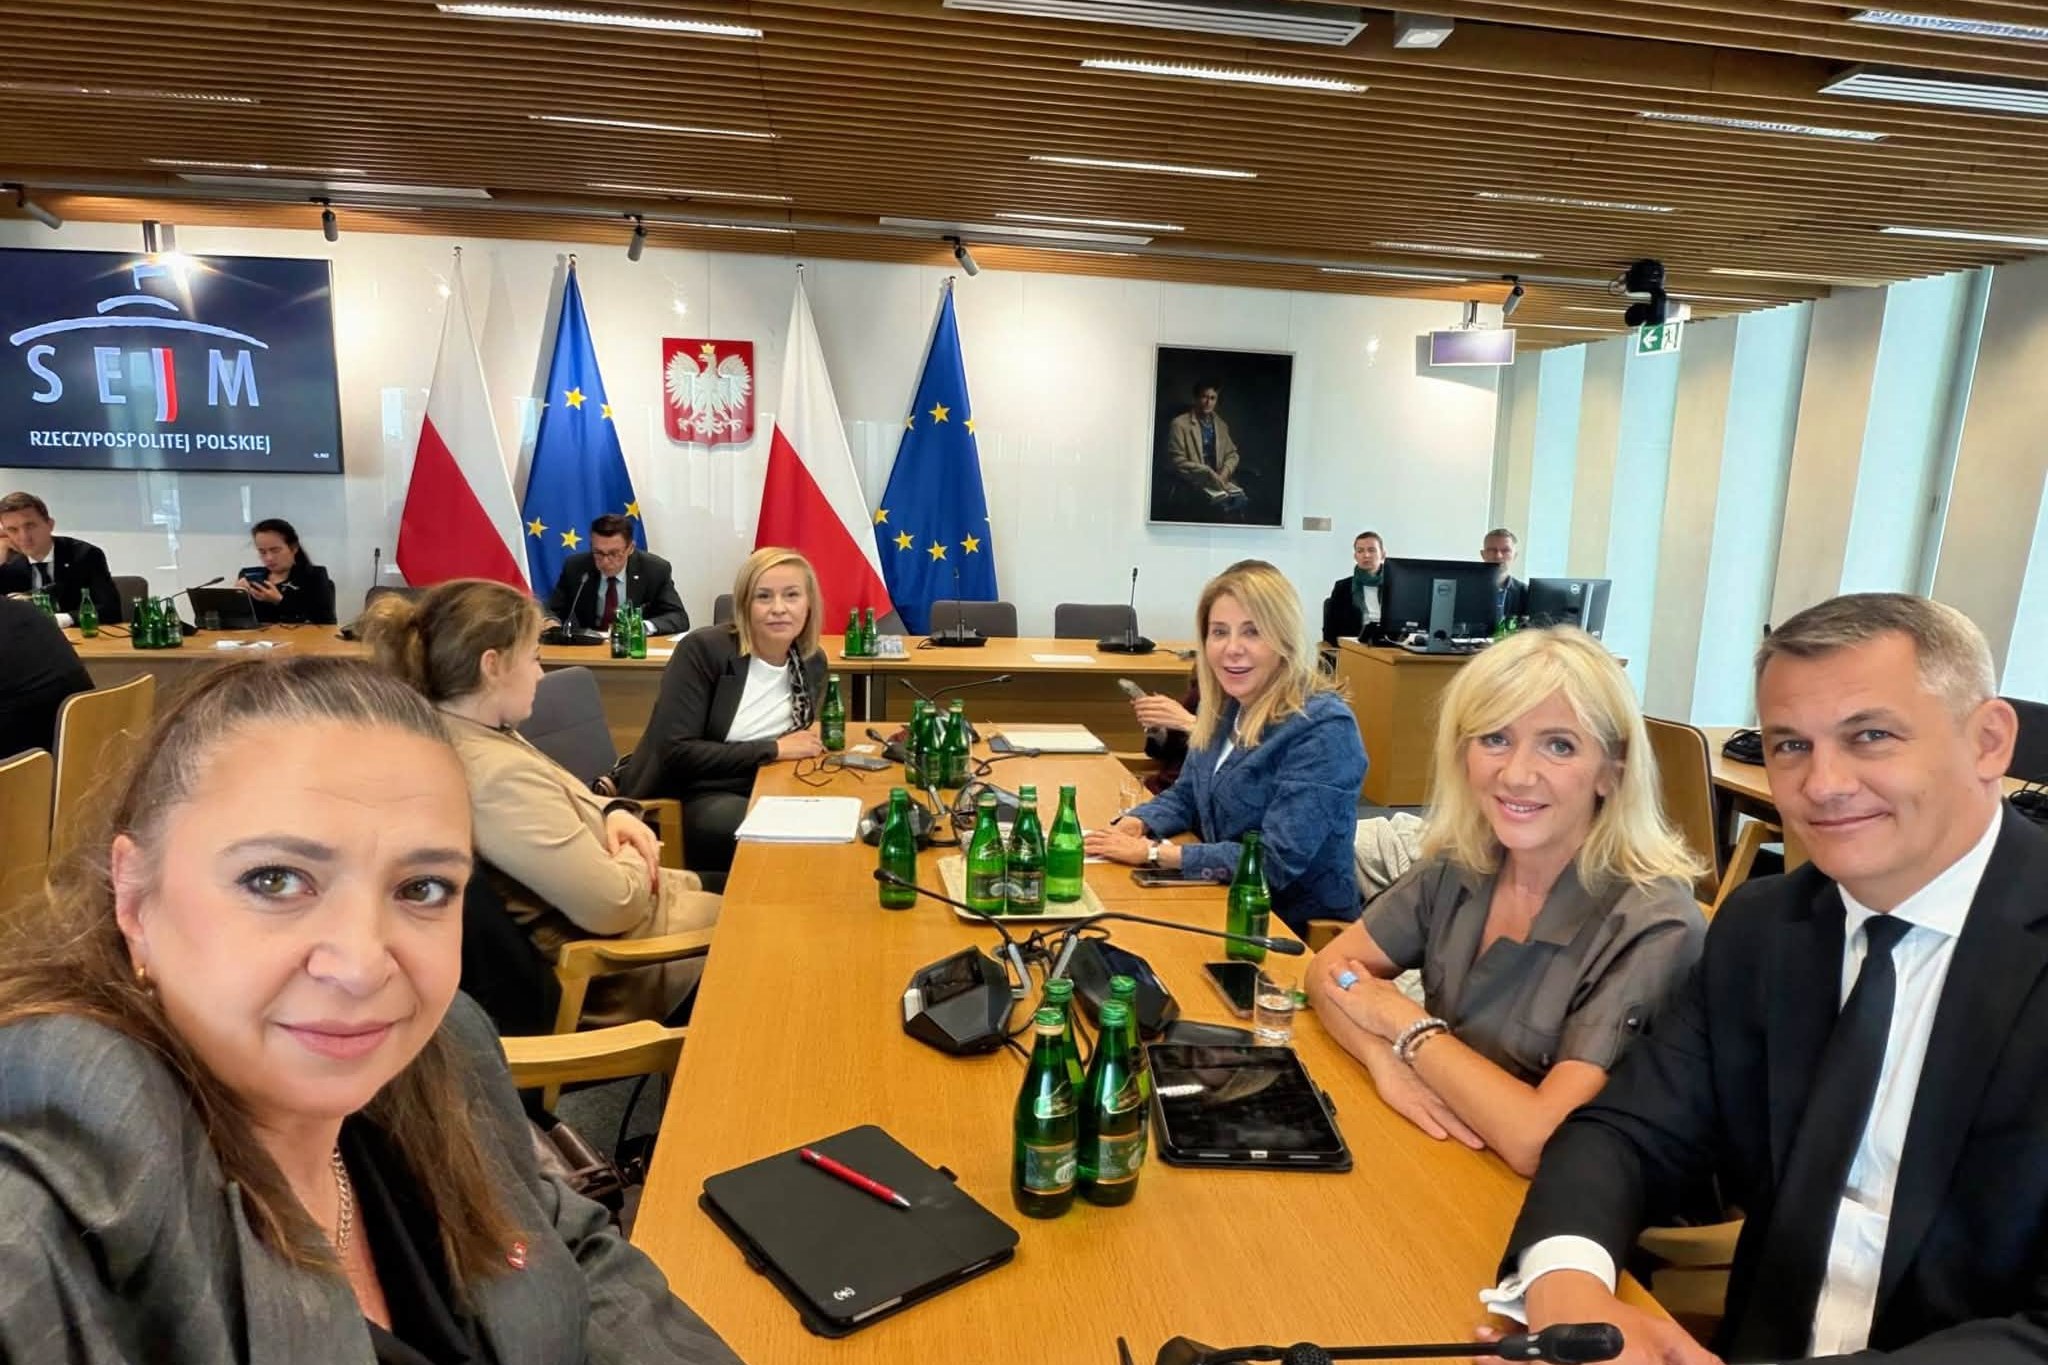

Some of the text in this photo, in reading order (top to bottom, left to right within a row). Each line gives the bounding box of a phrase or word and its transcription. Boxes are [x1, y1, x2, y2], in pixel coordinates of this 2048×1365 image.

[27, 345, 259, 422] SEJM
[30, 431, 271, 454] RZECZYPOSPOLITEJ POLSKIEJ
